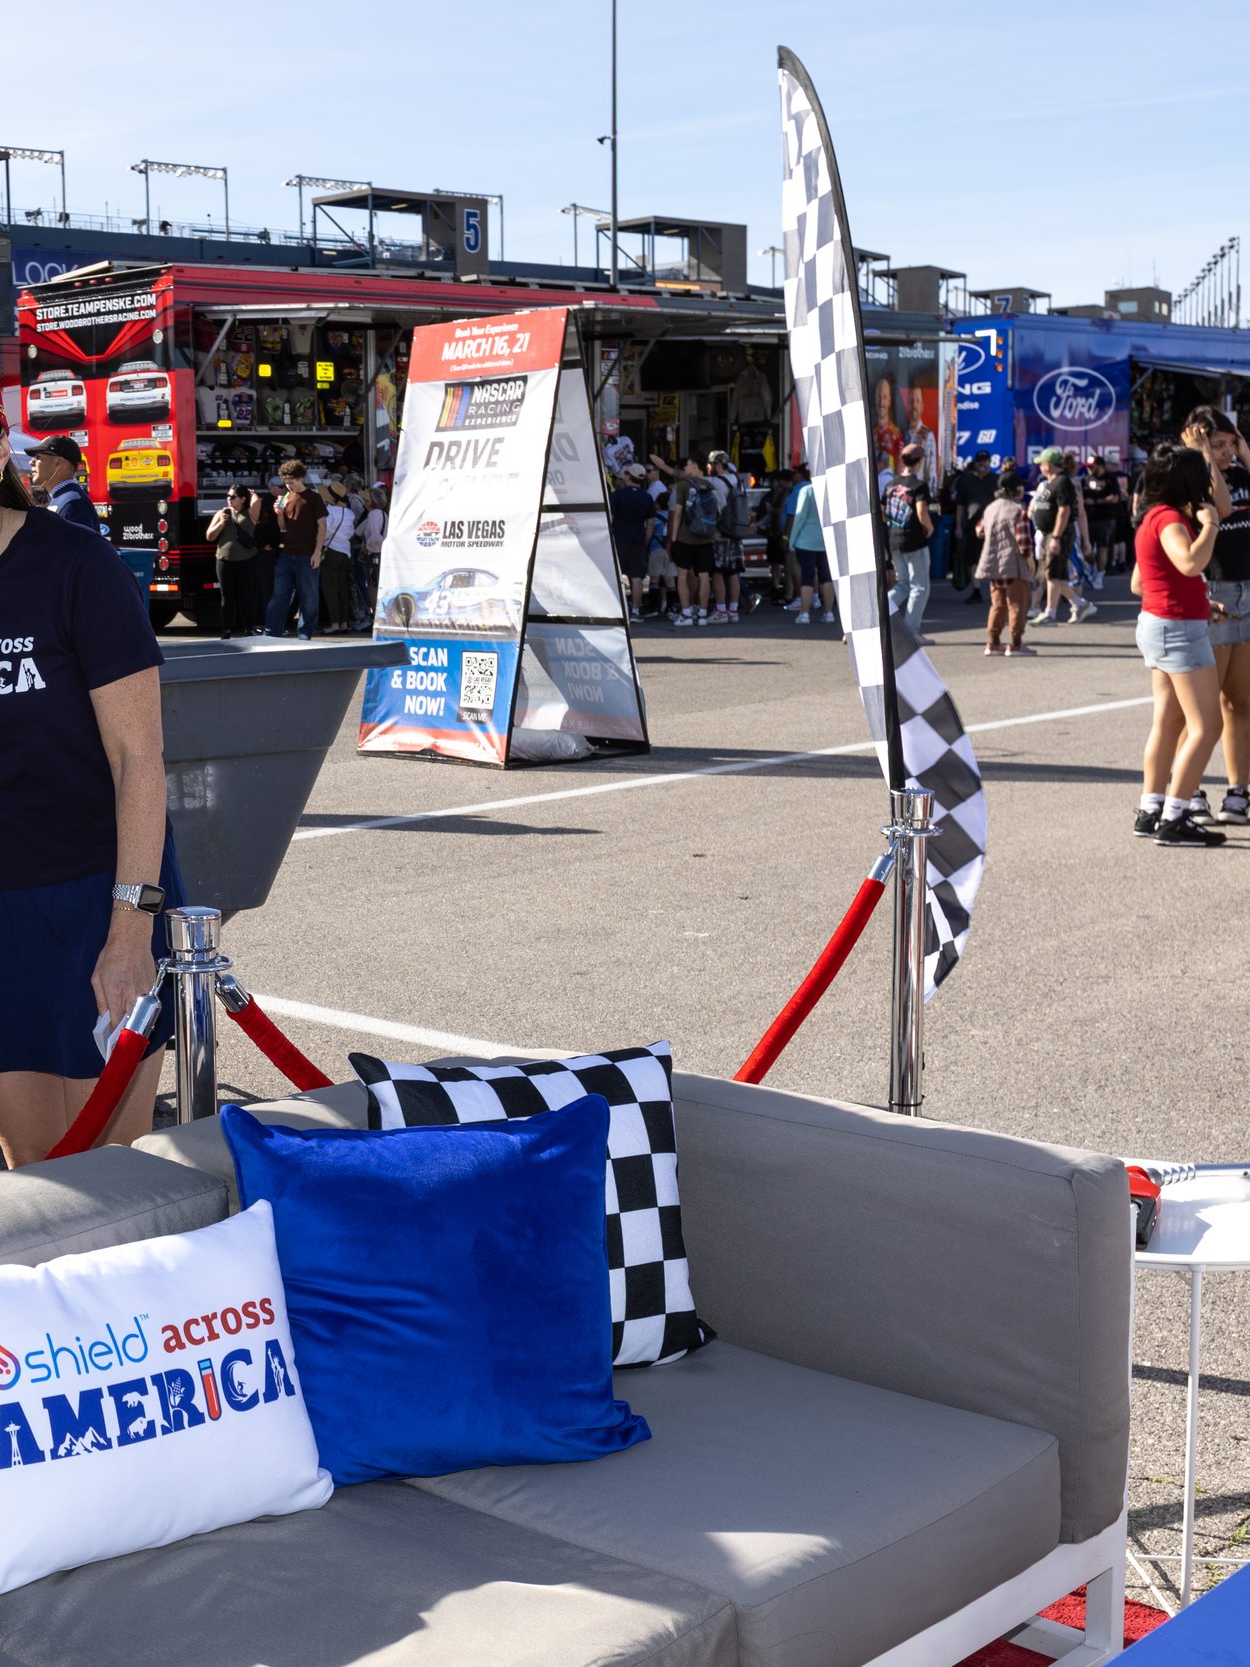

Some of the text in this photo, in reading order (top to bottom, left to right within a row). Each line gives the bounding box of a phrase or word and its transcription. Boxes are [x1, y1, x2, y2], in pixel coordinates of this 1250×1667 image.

[464, 208, 481, 253] 5
[36, 293, 157, 320] STORE.TEAMPENSKE.COM
[36, 309, 157, 332] STORE.WOODBROTHERSRACING.COM
[441, 332, 530, 361] MARCH 16, 21
[471, 380, 525, 404] NASCAR
[1050, 375, 1100, 419] Ford
[468, 402, 521, 415] RACING
[464, 415, 517, 426] EXPERIENCE
[422, 437, 505, 471] DRIVE
[442, 520, 506, 540] LAS VEGAS
[440, 540, 505, 548] MOTOR SPEEDWAY
[409, 646, 448, 667] SCAN
[391, 671, 447, 692] & BOOK
[404, 694, 445, 717] NOW!
[462, 711, 478, 720] SCAN
[161, 1297, 275, 1354] across
